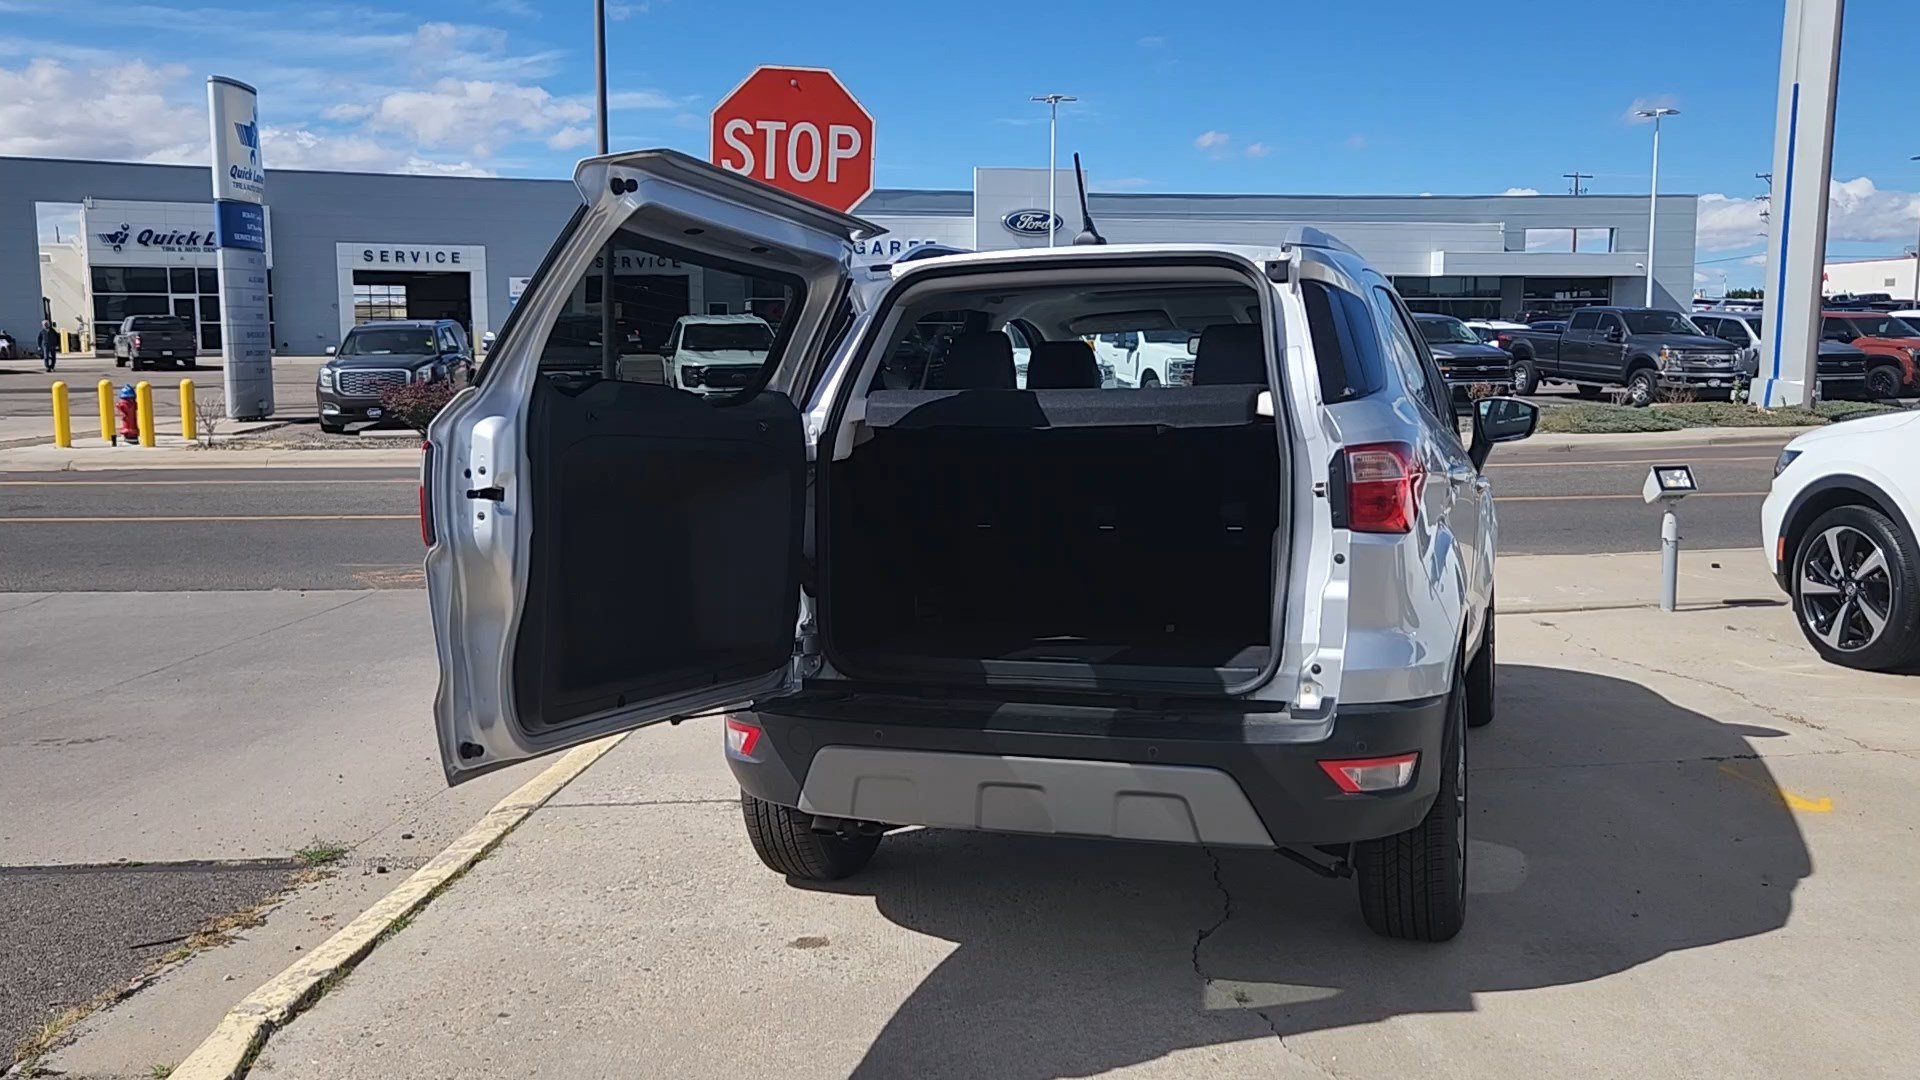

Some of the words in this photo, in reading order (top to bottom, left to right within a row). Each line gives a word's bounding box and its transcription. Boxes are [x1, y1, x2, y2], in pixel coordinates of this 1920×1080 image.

[721, 118, 862, 183] STOP
[230, 164, 253, 181] Quick
[1017, 213, 1052, 230] Ford
[137, 229, 201, 247] Quick
[363, 249, 461, 264] SERVICE
[853, 240, 937, 256] GAR
